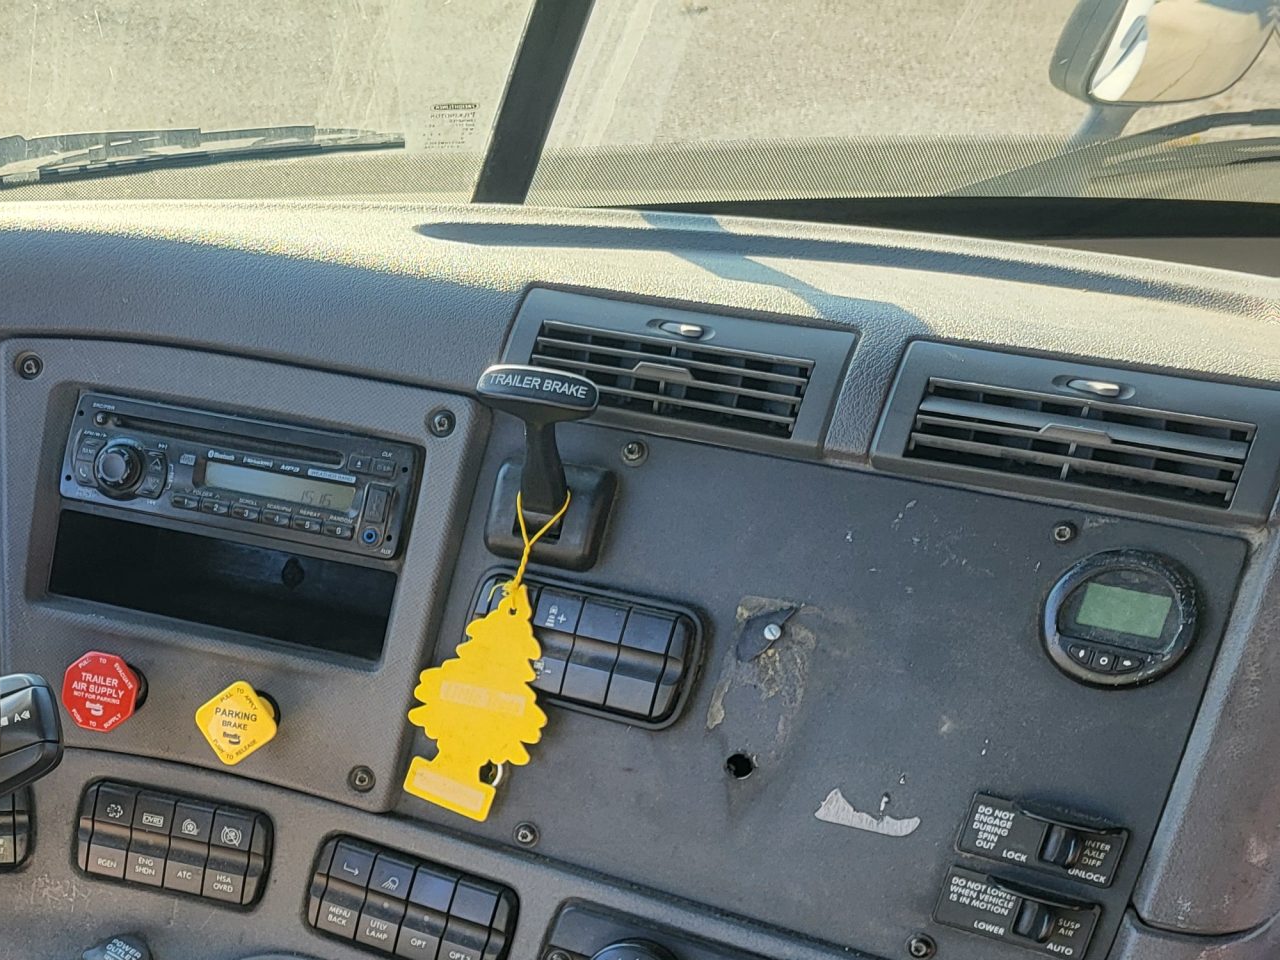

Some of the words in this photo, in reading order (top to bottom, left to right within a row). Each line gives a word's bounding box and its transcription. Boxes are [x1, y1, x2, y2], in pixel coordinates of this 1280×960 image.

[490, 374, 540, 389] TRAILER
[543, 380, 589, 398] BRAKE
[79, 658, 91, 668] PULL
[82, 672, 118, 687] TRAILER
[72, 681, 87, 691] AIR
[89, 685, 124, 698] SUPPLY
[97, 696, 119, 704] PARKING
[244, 695, 258, 711] APPLY
[104, 713, 121, 728] SUPPLY
[215, 707, 257, 722] PARKING
[222, 720, 248, 730] BRAKE
[236, 739, 256, 756] RELEASE
[978, 805, 992, 814] DO
[995, 809, 1015, 820] NOT
[144, 815, 163, 825] OVRD
[974, 814, 1012, 830] ENGAGE
[973, 822, 1008, 836] DURING
[978, 831, 998, 842] SPIN
[976, 839, 995, 850] OUT
[1085, 839, 1111, 851] INTER
[1002, 850, 1028, 862] LOCK
[1084, 849, 1106, 860] AXLE
[98, 858, 117, 868] RGEN
[138, 857, 154, 866] ENG
[1082, 857, 1102, 867] DIFF
[135, 866, 155, 876] SHDN
[177, 871, 192, 879] ATC
[1068, 867, 1106, 883] UNLOCK
[217, 874, 232, 883] HSA
[213, 882, 233, 892] OVRD
[952, 877, 966, 886] DO
[967, 881, 987, 892] NOT
[987, 887, 1016, 901] LOWER
[950, 885, 977, 898] WHEN
[980, 893, 1014, 908] VEHICLE
[950, 893, 957, 901] IS
[959, 896, 970, 904] IN
[971, 900, 1008, 916] MOTION
[329, 906, 351, 918] MENU
[328, 916, 346, 926] BACK
[1058, 918, 1080, 929] SUSP
[974, 920, 1005, 935] LOWER
[1058, 927, 1073, 936] AIR
[366, 929, 387, 940] LAMP
[112, 939, 141, 959] POWER
[411, 938, 426, 948] OPT
[1047, 943, 1073, 955] AUTO
